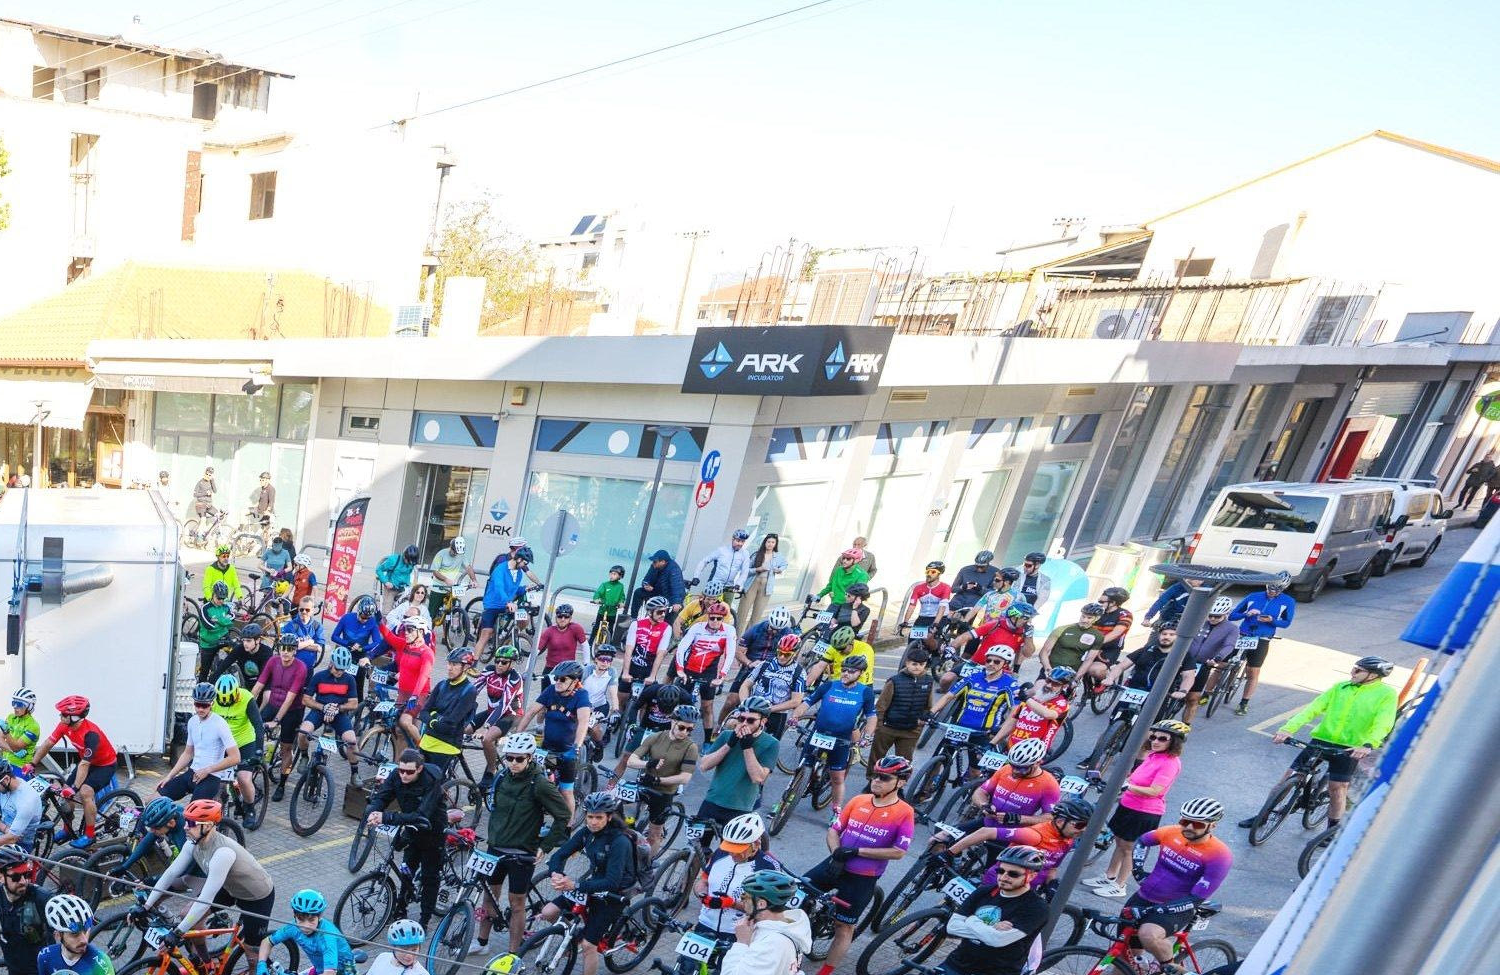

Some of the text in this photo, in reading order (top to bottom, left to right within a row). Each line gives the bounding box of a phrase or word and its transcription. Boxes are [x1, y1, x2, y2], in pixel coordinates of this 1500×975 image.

[737, 354, 804, 373] ARK
[845, 353, 884, 374] ARK
[482, 524, 512, 537] ARK
[814, 737, 832, 748] 174
[30, 780, 44, 793] 129
[1061, 779, 1083, 792] 214
[617, 788, 634, 799] 162
[1009, 789, 1033, 804] COAST
[863, 824, 889, 837] COAST
[473, 856, 494, 873] 119
[1163, 847, 1200, 871] WEST COAST
[681, 940, 709, 958] 104
